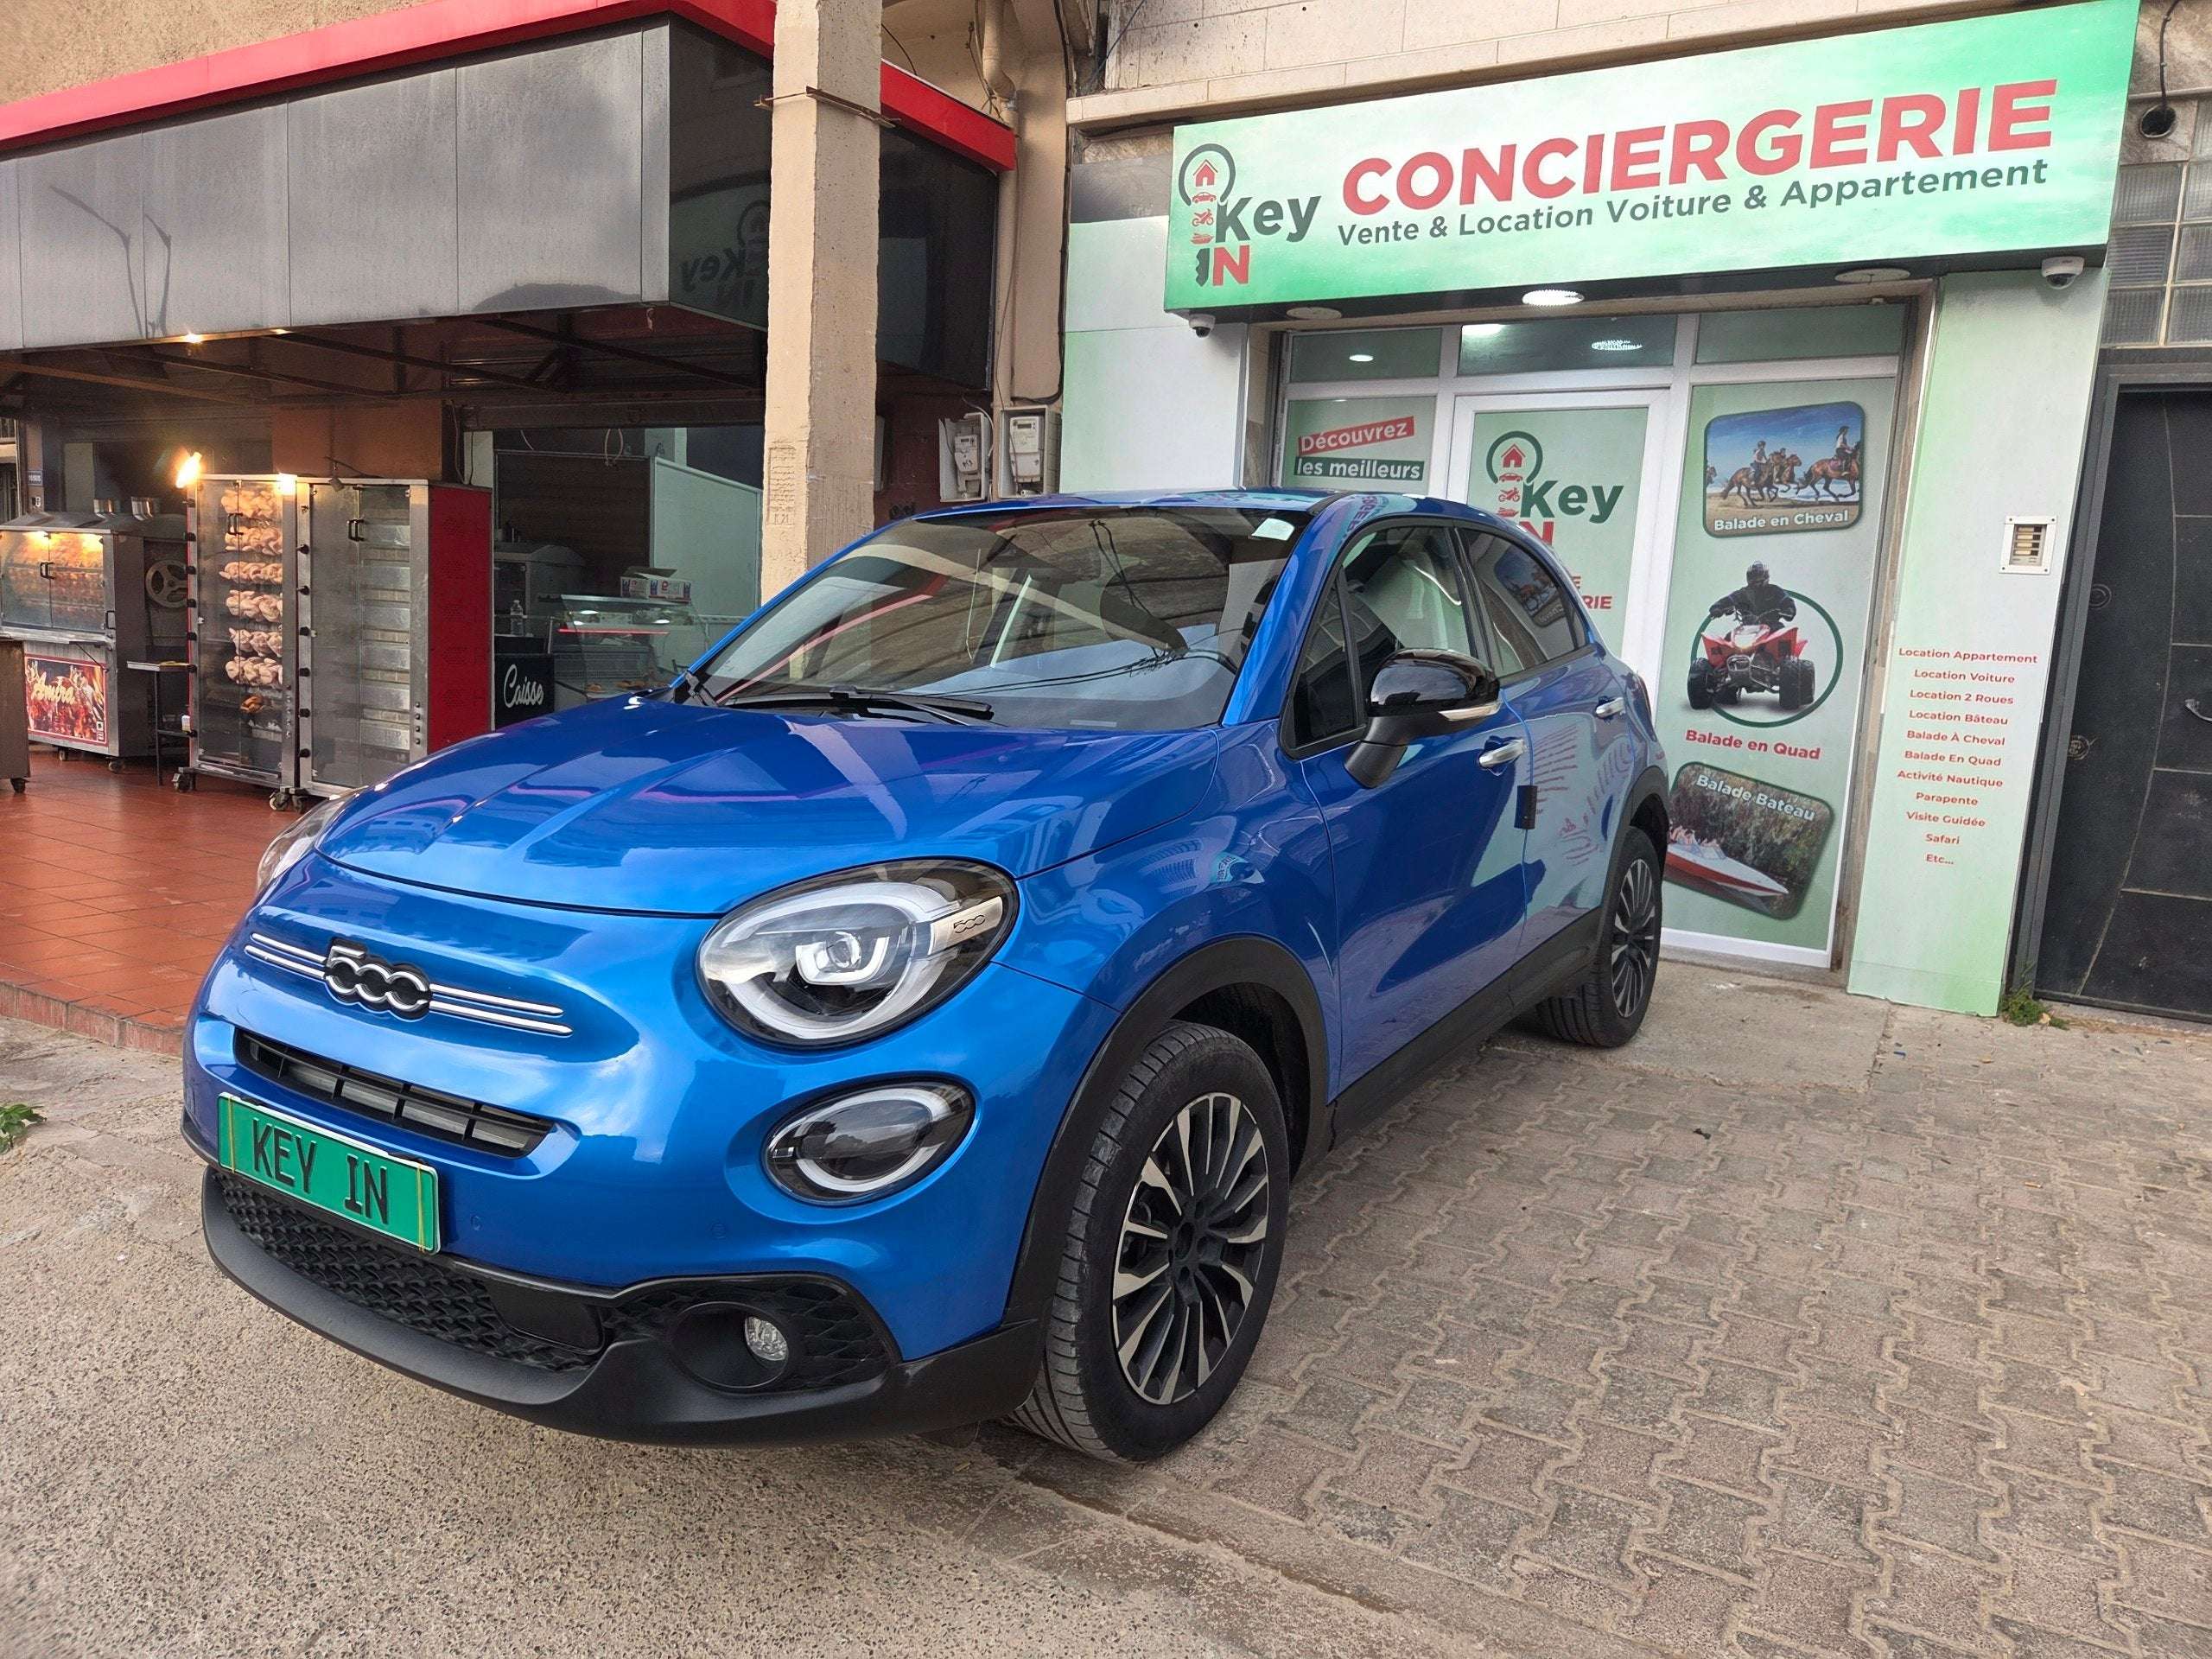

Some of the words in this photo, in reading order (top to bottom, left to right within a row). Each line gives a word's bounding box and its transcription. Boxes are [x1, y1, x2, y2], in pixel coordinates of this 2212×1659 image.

[1342, 79, 2058, 216] CONCIERGERIE
[1338, 219, 1420, 247] Vente
[1428, 216, 1449, 238] &
[1459, 203, 1593, 237] Location
[1606, 188, 1732, 223] Voiture
[1744, 184, 1768, 210] &
[1781, 158, 2049, 209] Appartement
[1216, 196, 1322, 243] Key
[1301, 423, 1408, 452] Découvrez
[1297, 458, 1323, 475] les
[1329, 460, 1421, 480] meilleurs
[1520, 480, 1624, 524] Key
[1714, 517, 1766, 531] Balade
[1770, 517, 1789, 526] en
[1794, 510, 1848, 524] Cheval
[1899, 648, 1950, 658] Location
[1954, 651, 2038, 664] Appartement
[504, 664, 544, 709] Caisse
[1914, 670, 1966, 681] Location
[1970, 673, 2015, 683] Voiture
[1910, 690, 1961, 701] Location
[1975, 694, 2014, 704] Roues
[1909, 710, 1961, 721] Location
[1686, 729, 1743, 748] Balade
[1747, 741, 1768, 752] en
[1773, 742, 1821, 760] Quad
[1907, 730, 1948, 741] Balade
[1963, 734, 2005, 746] Cheval
[1904, 751, 1945, 762] Balade
[1949, 754, 1964, 763] En
[1968, 756, 2001, 766] Quad
[1897, 770, 1943, 781] Activité
[1947, 775, 2003, 787] Nautique
[1696, 774, 1752, 801] Balade
[1756, 792, 1815, 821] Bateau
[1916, 792, 1978, 806] Parapente
[1906, 811, 1939, 823] Visite
[1942, 815, 1986, 827] Guidée
[1925, 834, 1961, 845] Safari
[953, 914, 986, 934] 500
[326, 940, 430, 1016] 500
[253, 1119, 317, 1193] KEY
[344, 1153, 389, 1225] IN
